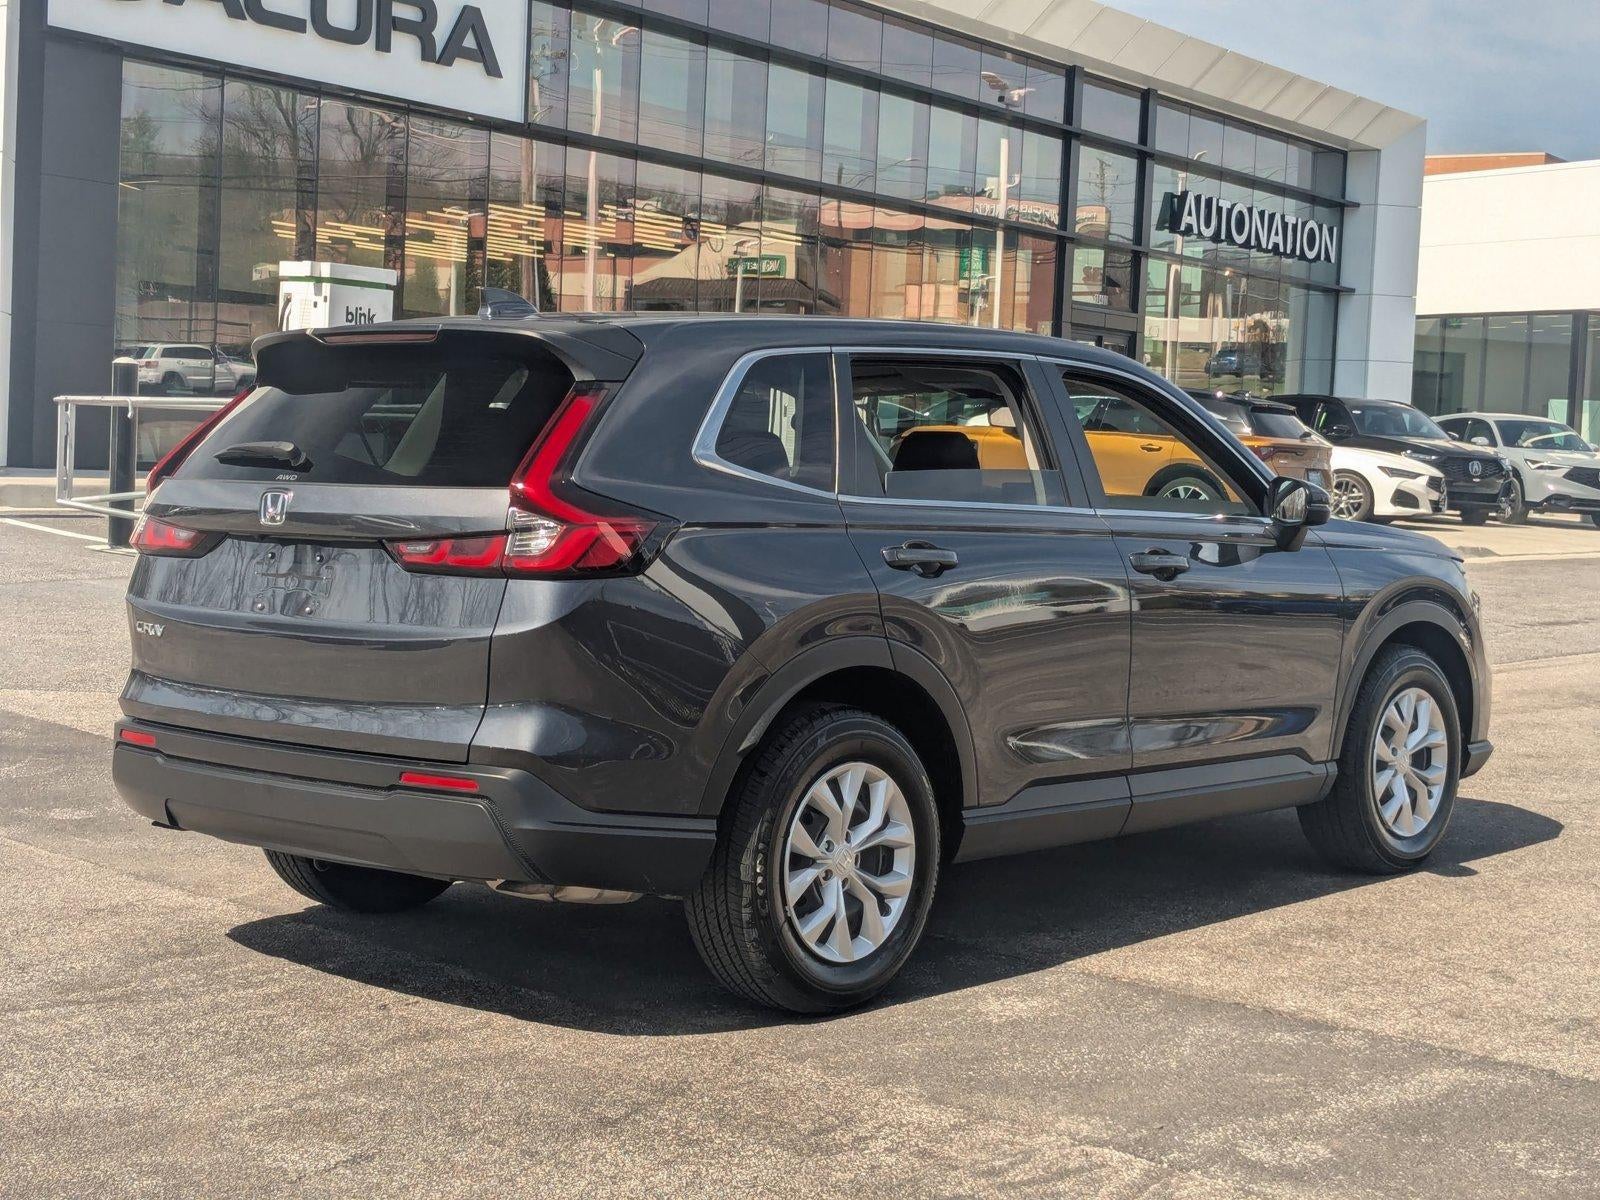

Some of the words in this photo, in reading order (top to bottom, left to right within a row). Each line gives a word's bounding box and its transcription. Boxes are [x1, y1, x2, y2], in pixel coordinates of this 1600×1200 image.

[162, 0, 504, 79] URA
[1179, 190, 1338, 264] AUTONATION
[345, 305, 377, 326] blink
